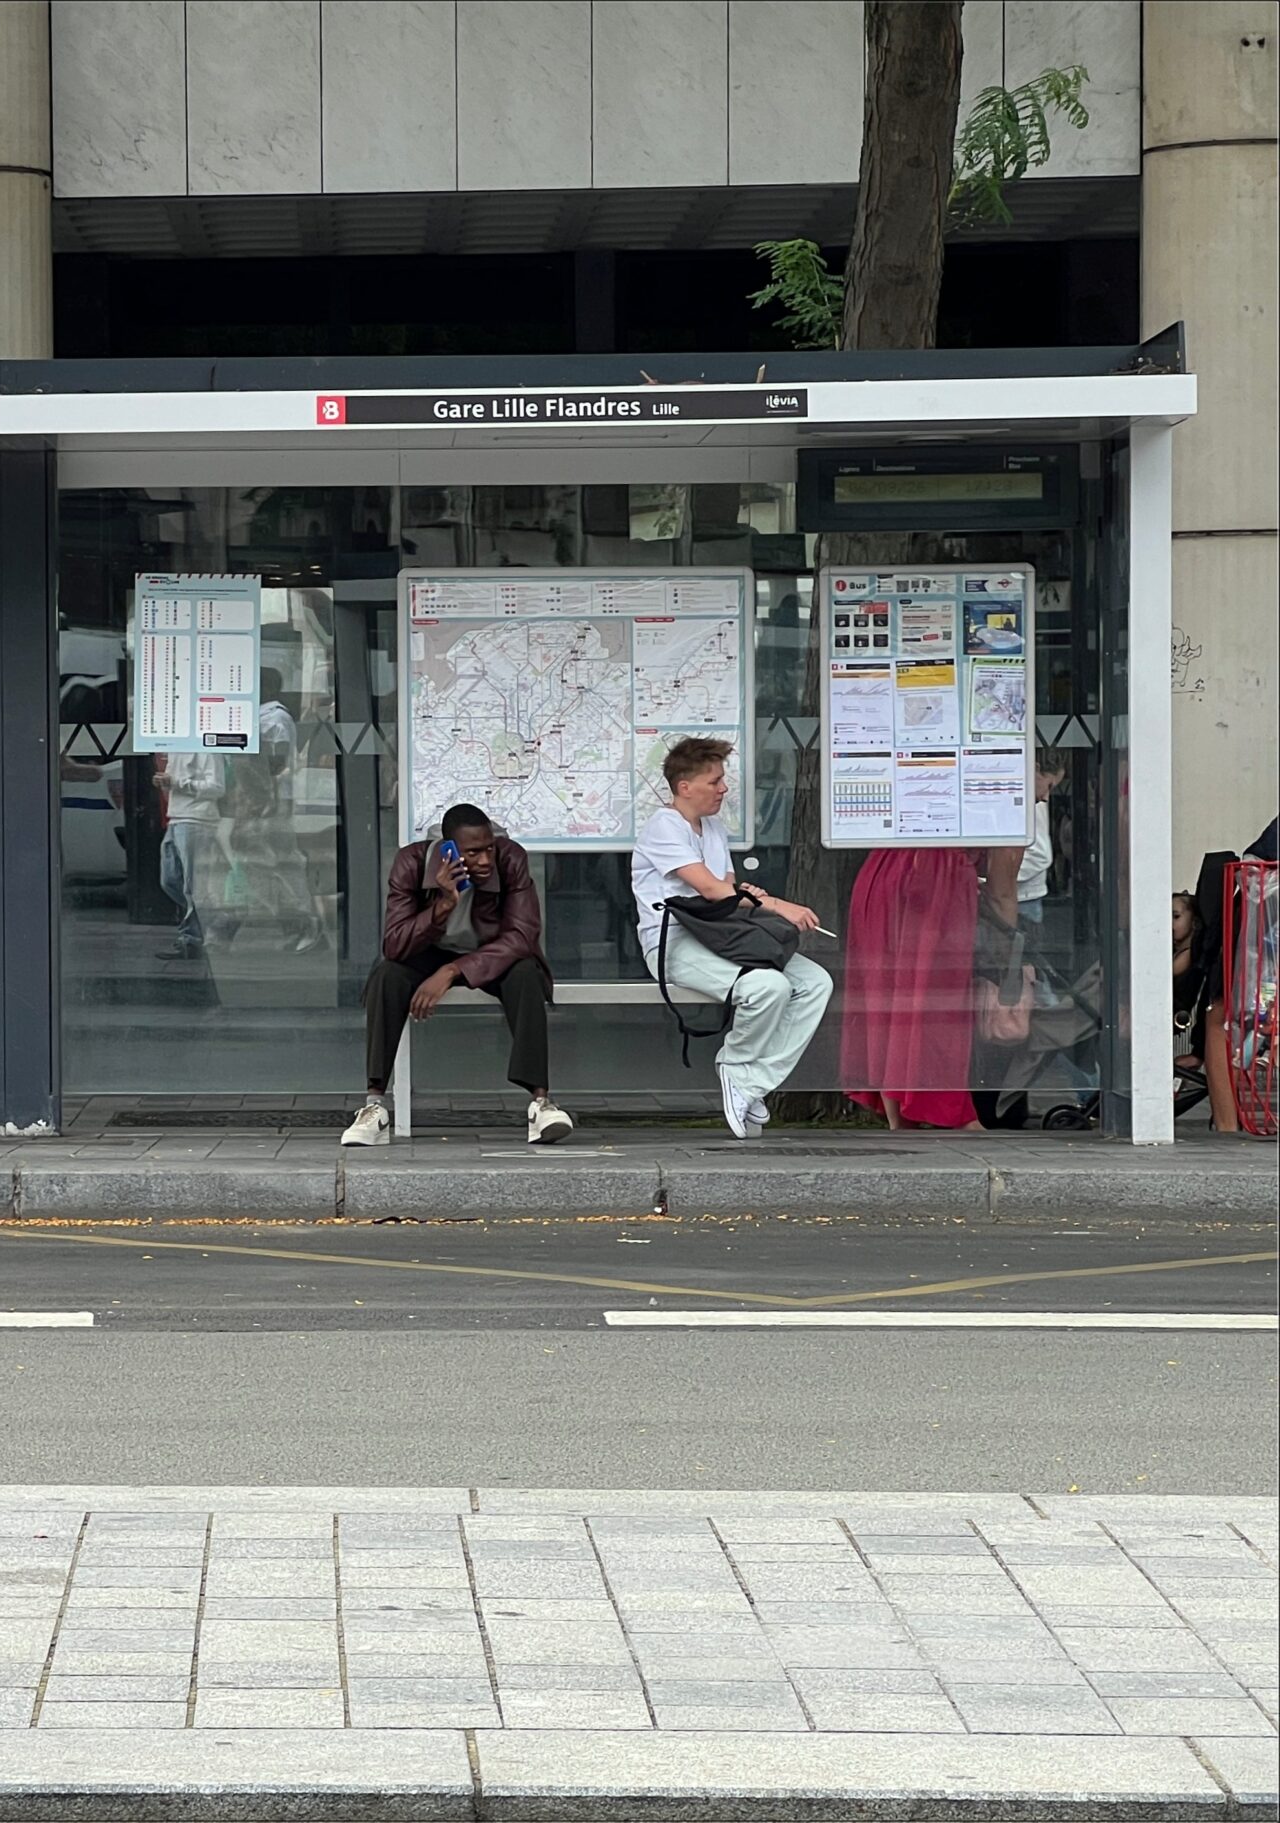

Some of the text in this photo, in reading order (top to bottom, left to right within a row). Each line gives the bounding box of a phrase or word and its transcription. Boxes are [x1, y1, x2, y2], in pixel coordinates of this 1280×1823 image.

[433, 397, 680, 418] Gare Lille Flandres Lille
[849, 582, 866, 590] Bus
